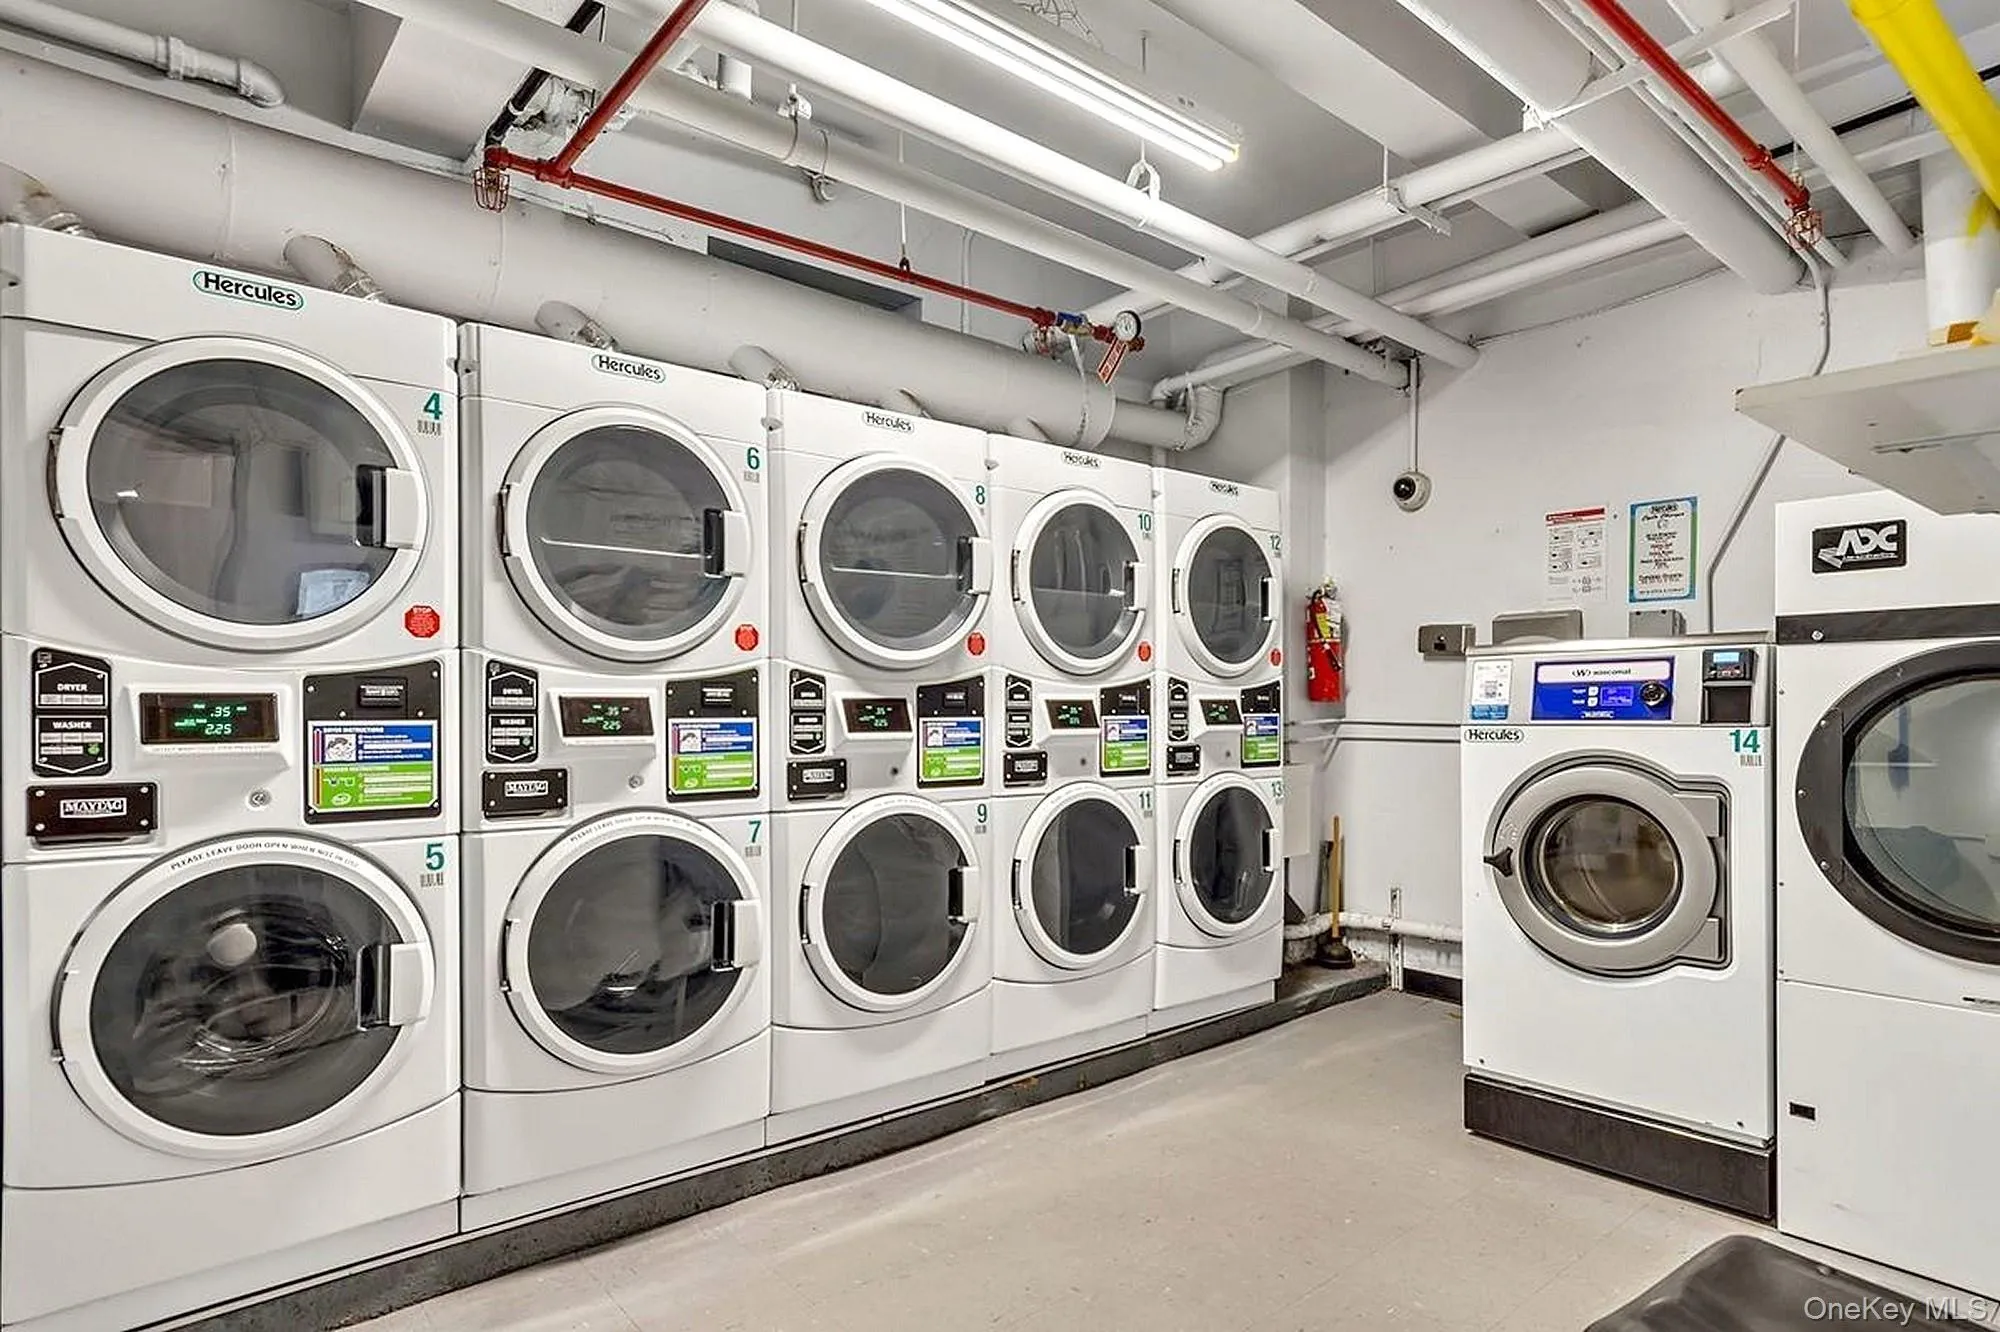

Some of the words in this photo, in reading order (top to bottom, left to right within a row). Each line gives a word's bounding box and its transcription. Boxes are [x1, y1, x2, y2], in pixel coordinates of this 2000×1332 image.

[204, 272, 297, 306] Hercules
[599, 355, 661, 380] Hercules
[423, 392, 443, 420] 4
[866, 411, 911, 431] Hercules
[747, 447, 760, 470] 6
[976, 485, 985, 505] 8
[1138, 513, 1151, 531] 10
[1270, 534, 1281, 550] 12
[1836, 525, 1898, 556] ADC
[57, 683, 88, 692] DRYER
[53, 721, 92, 729] WASHER
[1468, 728, 1519, 741] Hercules
[1729, 729, 1760, 753] 14
[64, 800, 122, 812] MAYTAG
[1139, 791, 1151, 809] 11
[977, 803, 987, 823] 9
[748, 820, 761, 843] 7
[171, 854, 203, 870] PLEASE
[206, 847, 233, 858] LEAVE
[426, 843, 444, 870] 5
